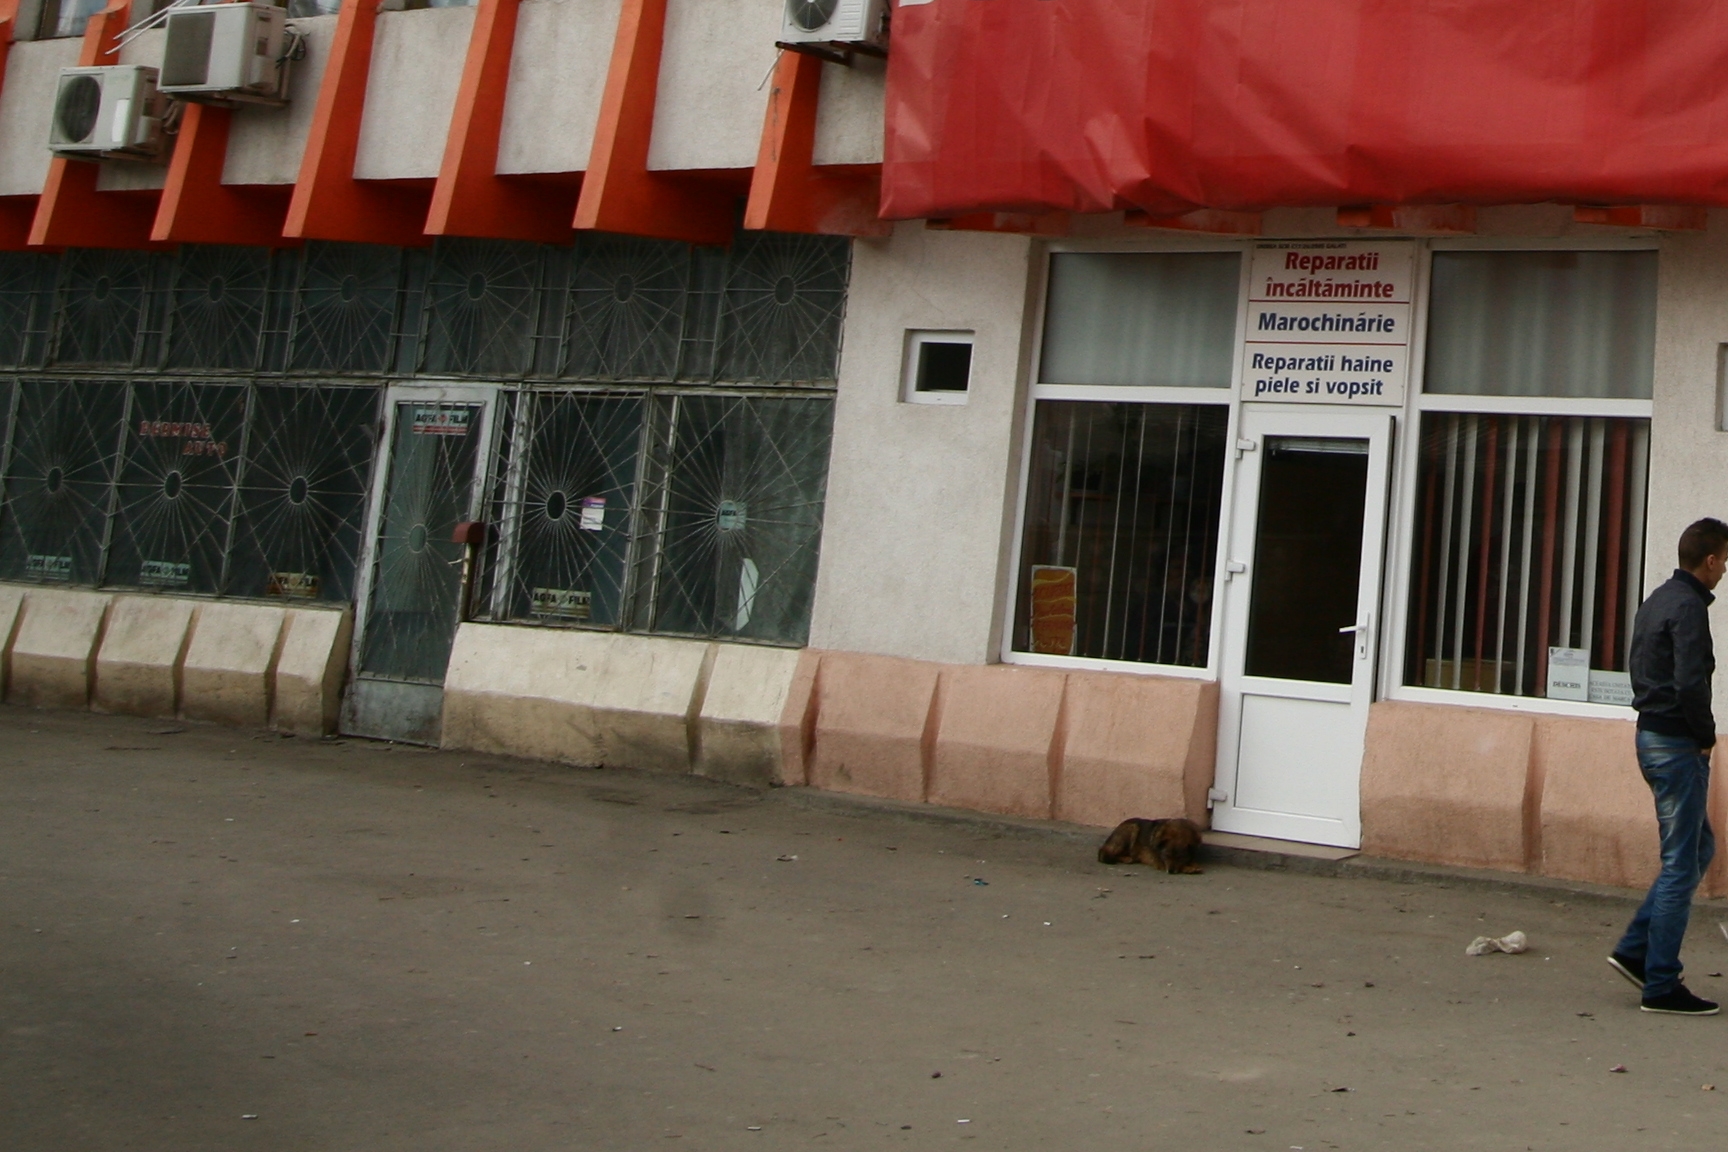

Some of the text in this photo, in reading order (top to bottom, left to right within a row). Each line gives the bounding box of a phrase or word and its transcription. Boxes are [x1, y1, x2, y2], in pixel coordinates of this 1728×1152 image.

[1285, 252, 1380, 275] Reparatii
[1252, 353, 1393, 374] Reparatii haine
[1255, 377, 1383, 399] piele si vopsit
[534, 593, 557, 603] AGFA
